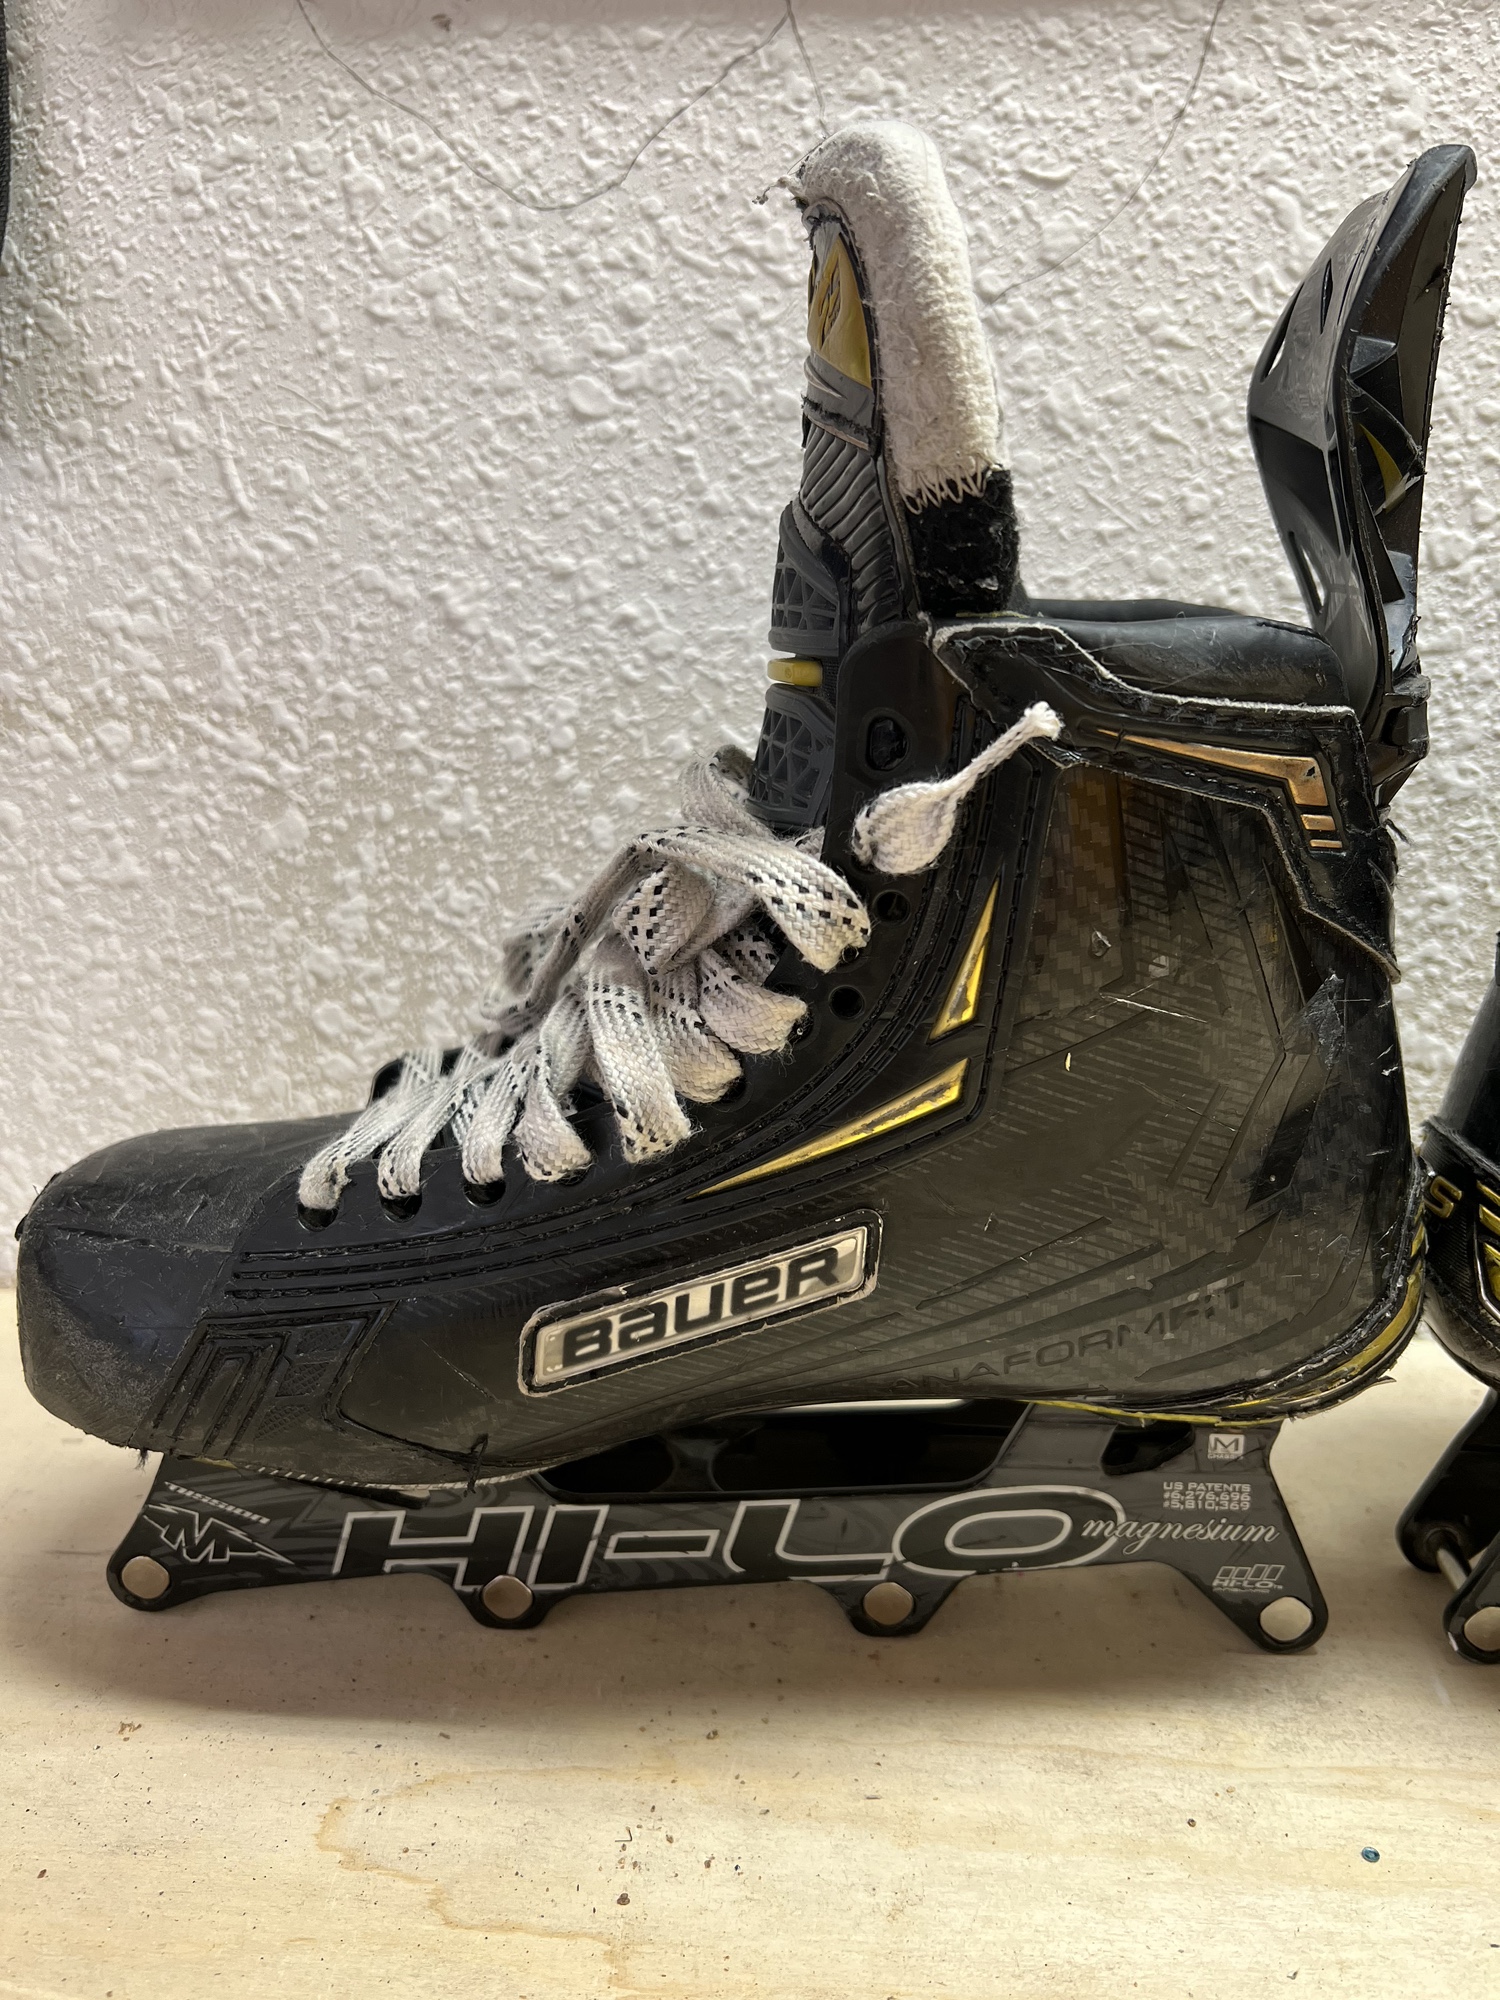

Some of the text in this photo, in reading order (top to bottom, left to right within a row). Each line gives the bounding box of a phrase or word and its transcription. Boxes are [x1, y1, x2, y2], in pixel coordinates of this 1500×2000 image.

[1163, 1481, 1252, 1493] US PATENTS
[1163, 1490, 1252, 1502] #6,276,696
[1162, 1499, 1251, 1511] #5,810,369
[332, 1486, 1126, 1592] HI-LO
[1080, 1517, 1281, 1556] magnesium
